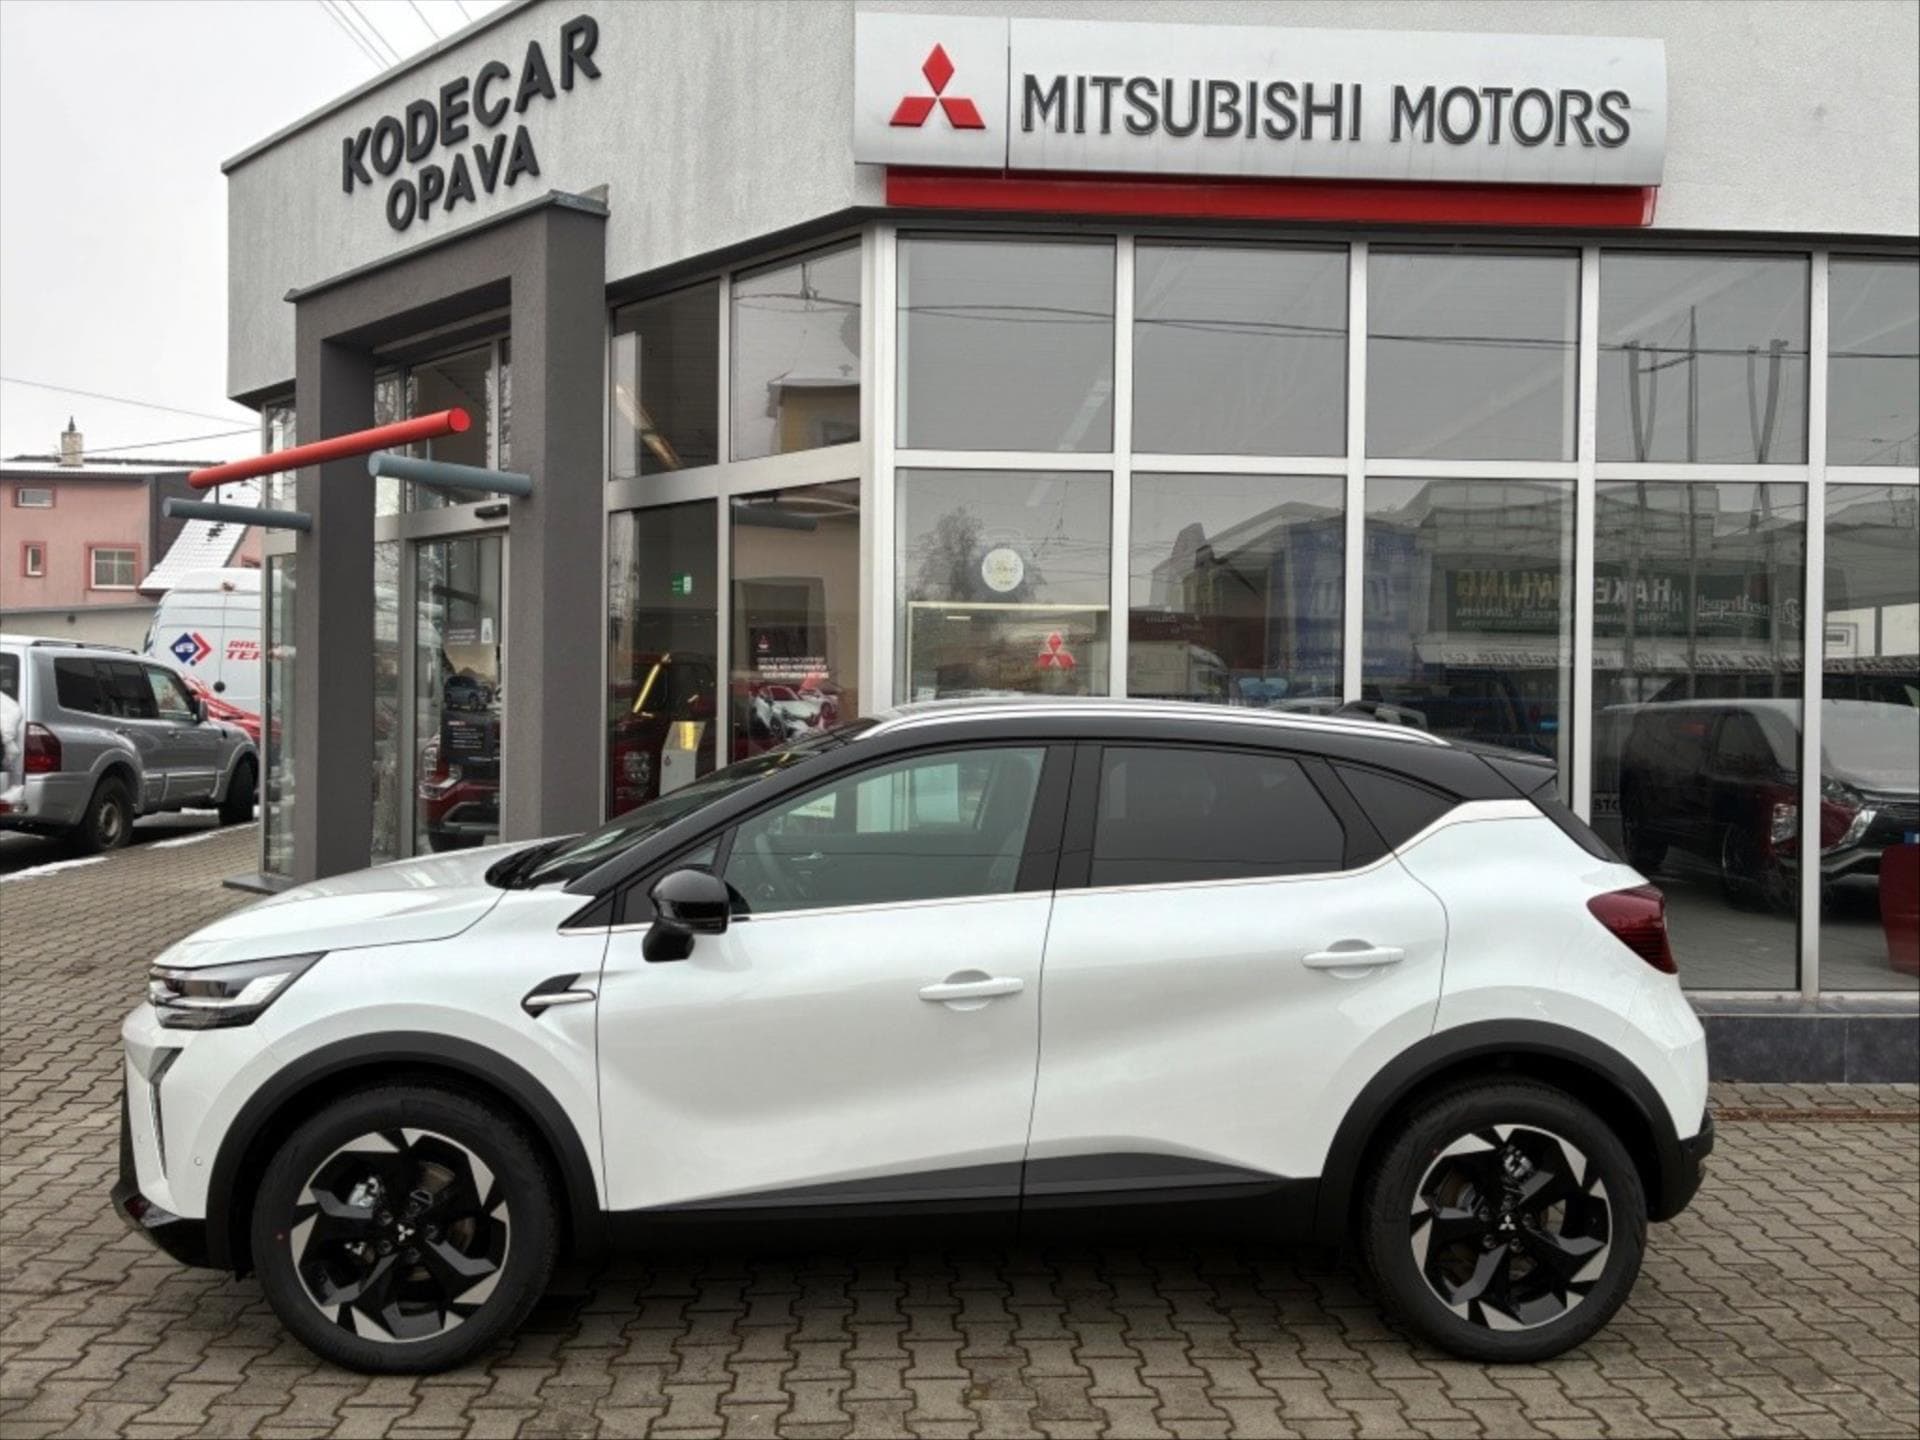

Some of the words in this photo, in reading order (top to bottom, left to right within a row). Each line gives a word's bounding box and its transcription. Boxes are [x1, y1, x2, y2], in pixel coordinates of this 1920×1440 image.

[342, 14, 602, 194] KODECAR
[1022, 74, 1362, 142] MITSUBISHI
[1391, 85, 1631, 148] MOTORS
[386, 124, 541, 232] OPAVA
